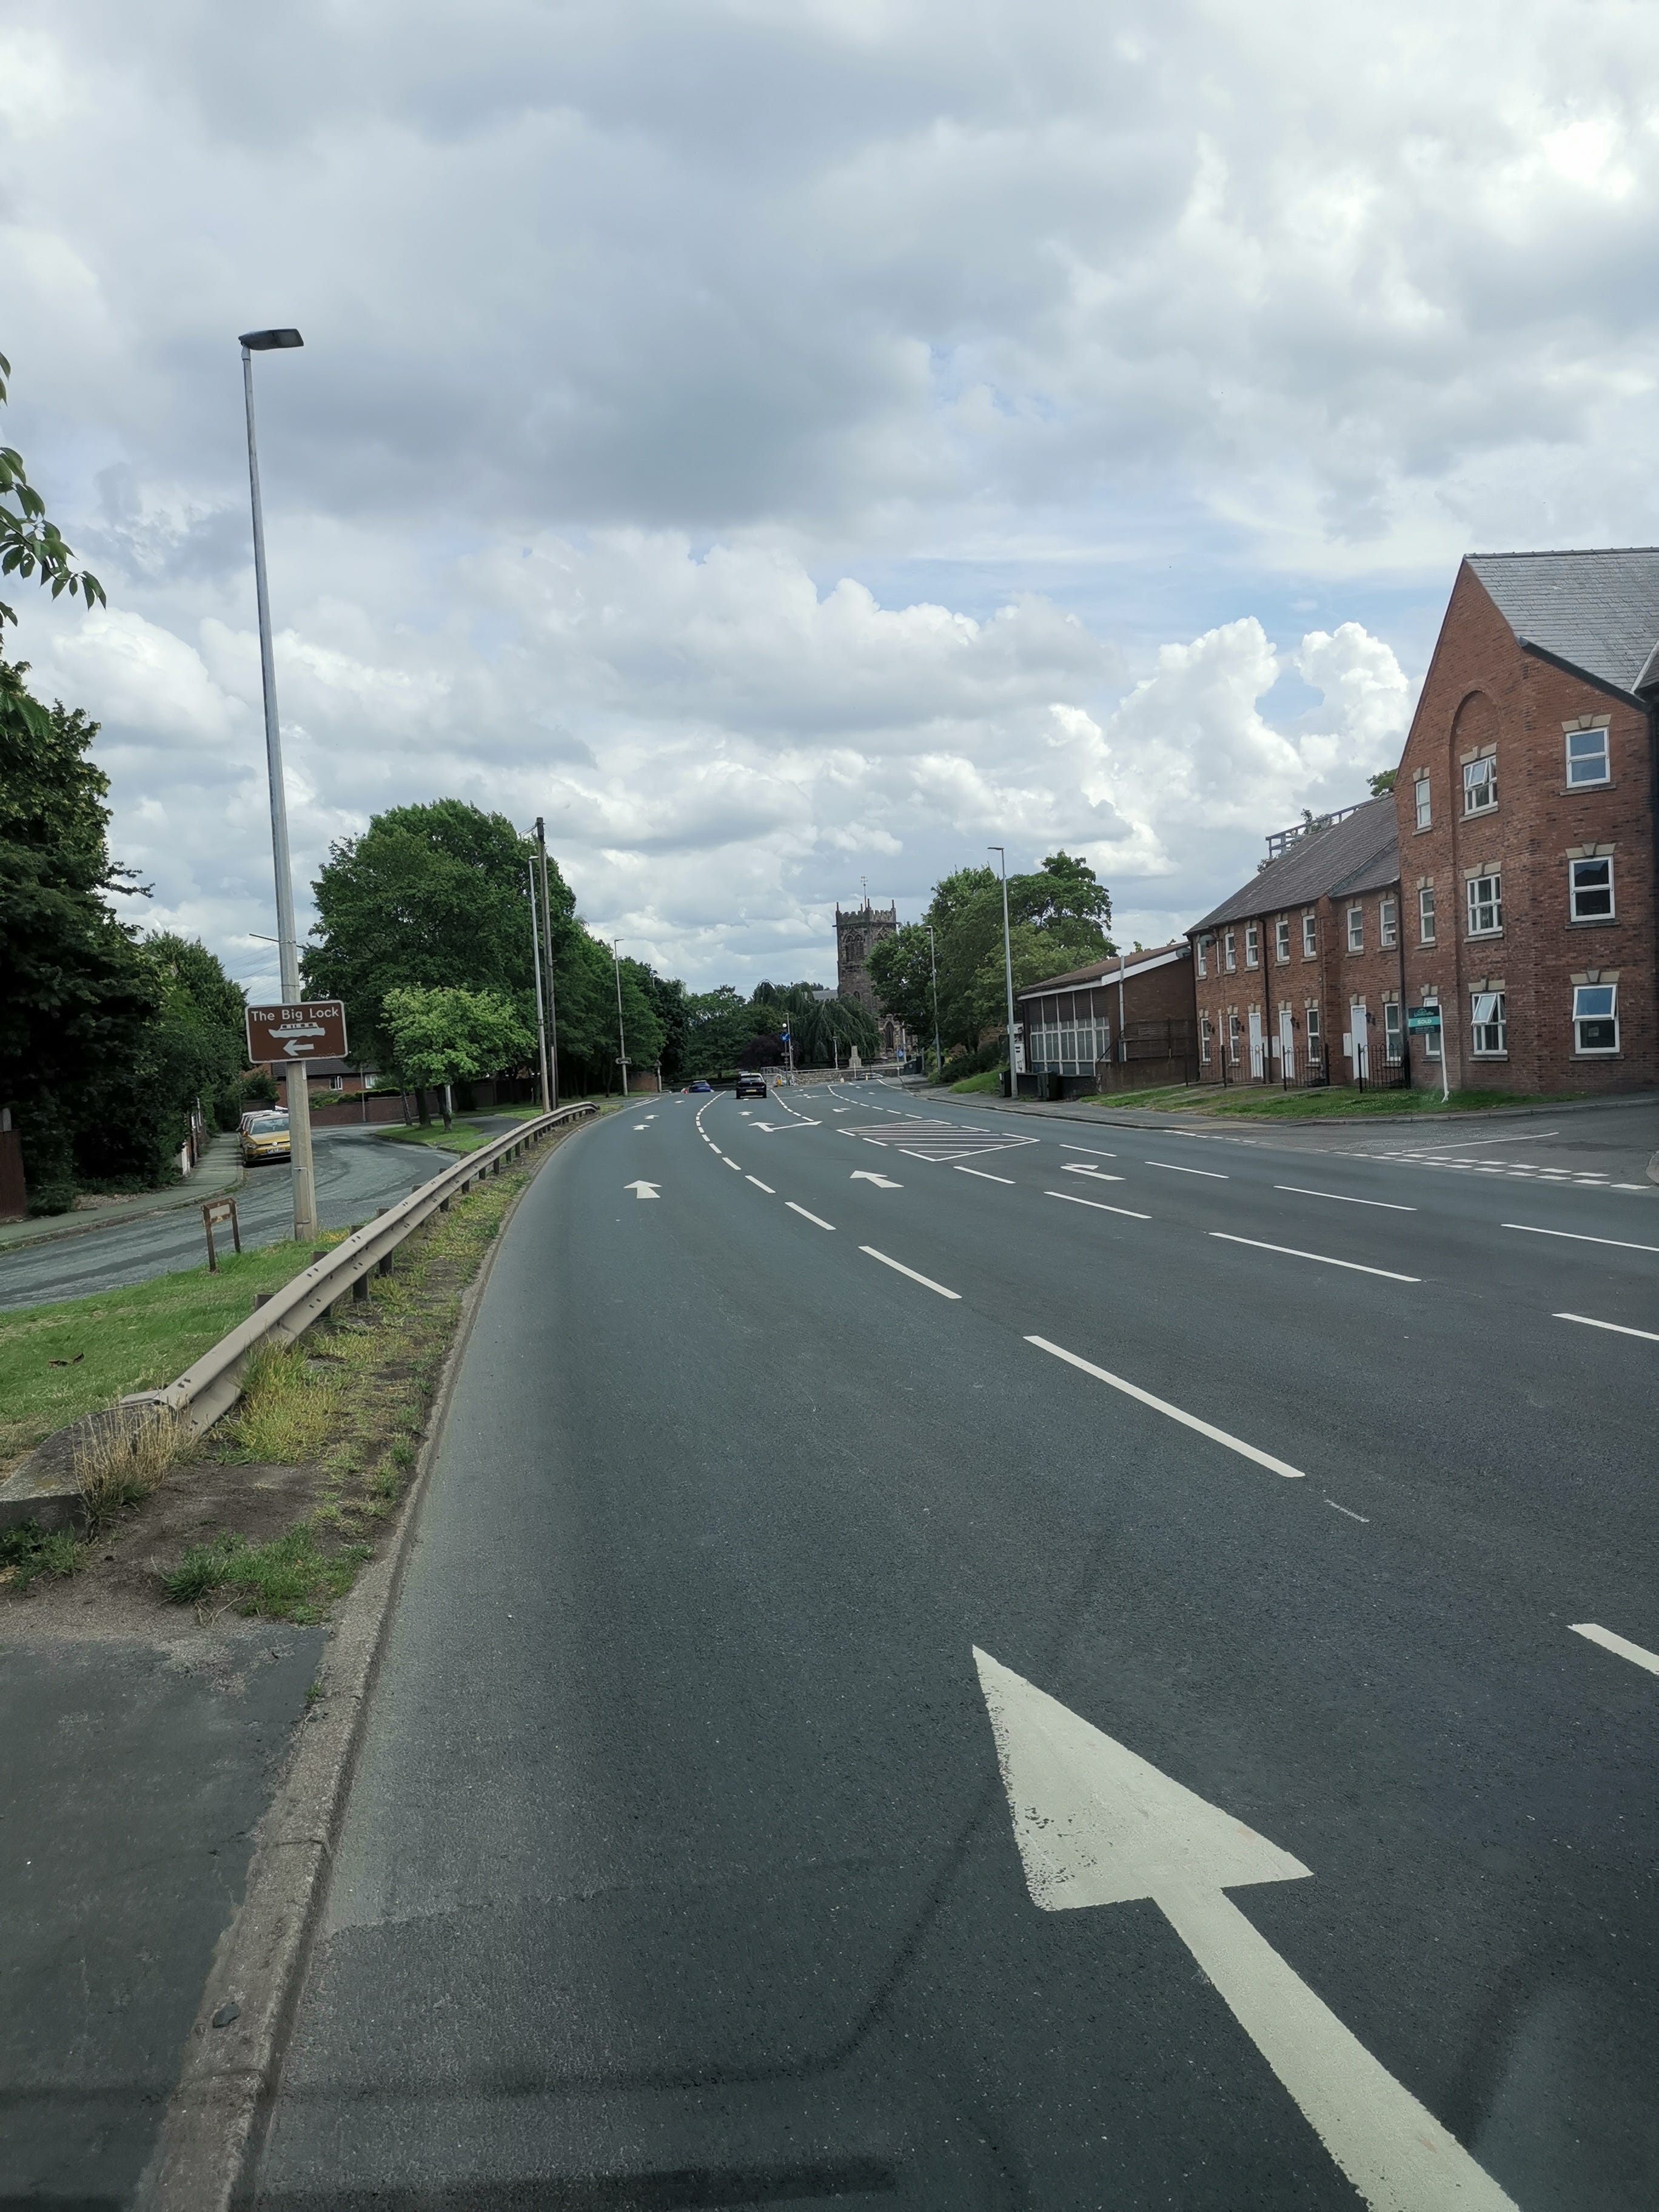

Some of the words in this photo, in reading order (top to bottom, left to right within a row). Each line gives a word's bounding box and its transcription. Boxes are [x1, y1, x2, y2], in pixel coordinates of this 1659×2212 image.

[251, 1011, 275, 1022] The
[281, 1008, 303, 1021] Big
[309, 1007, 339, 1019] Lock
